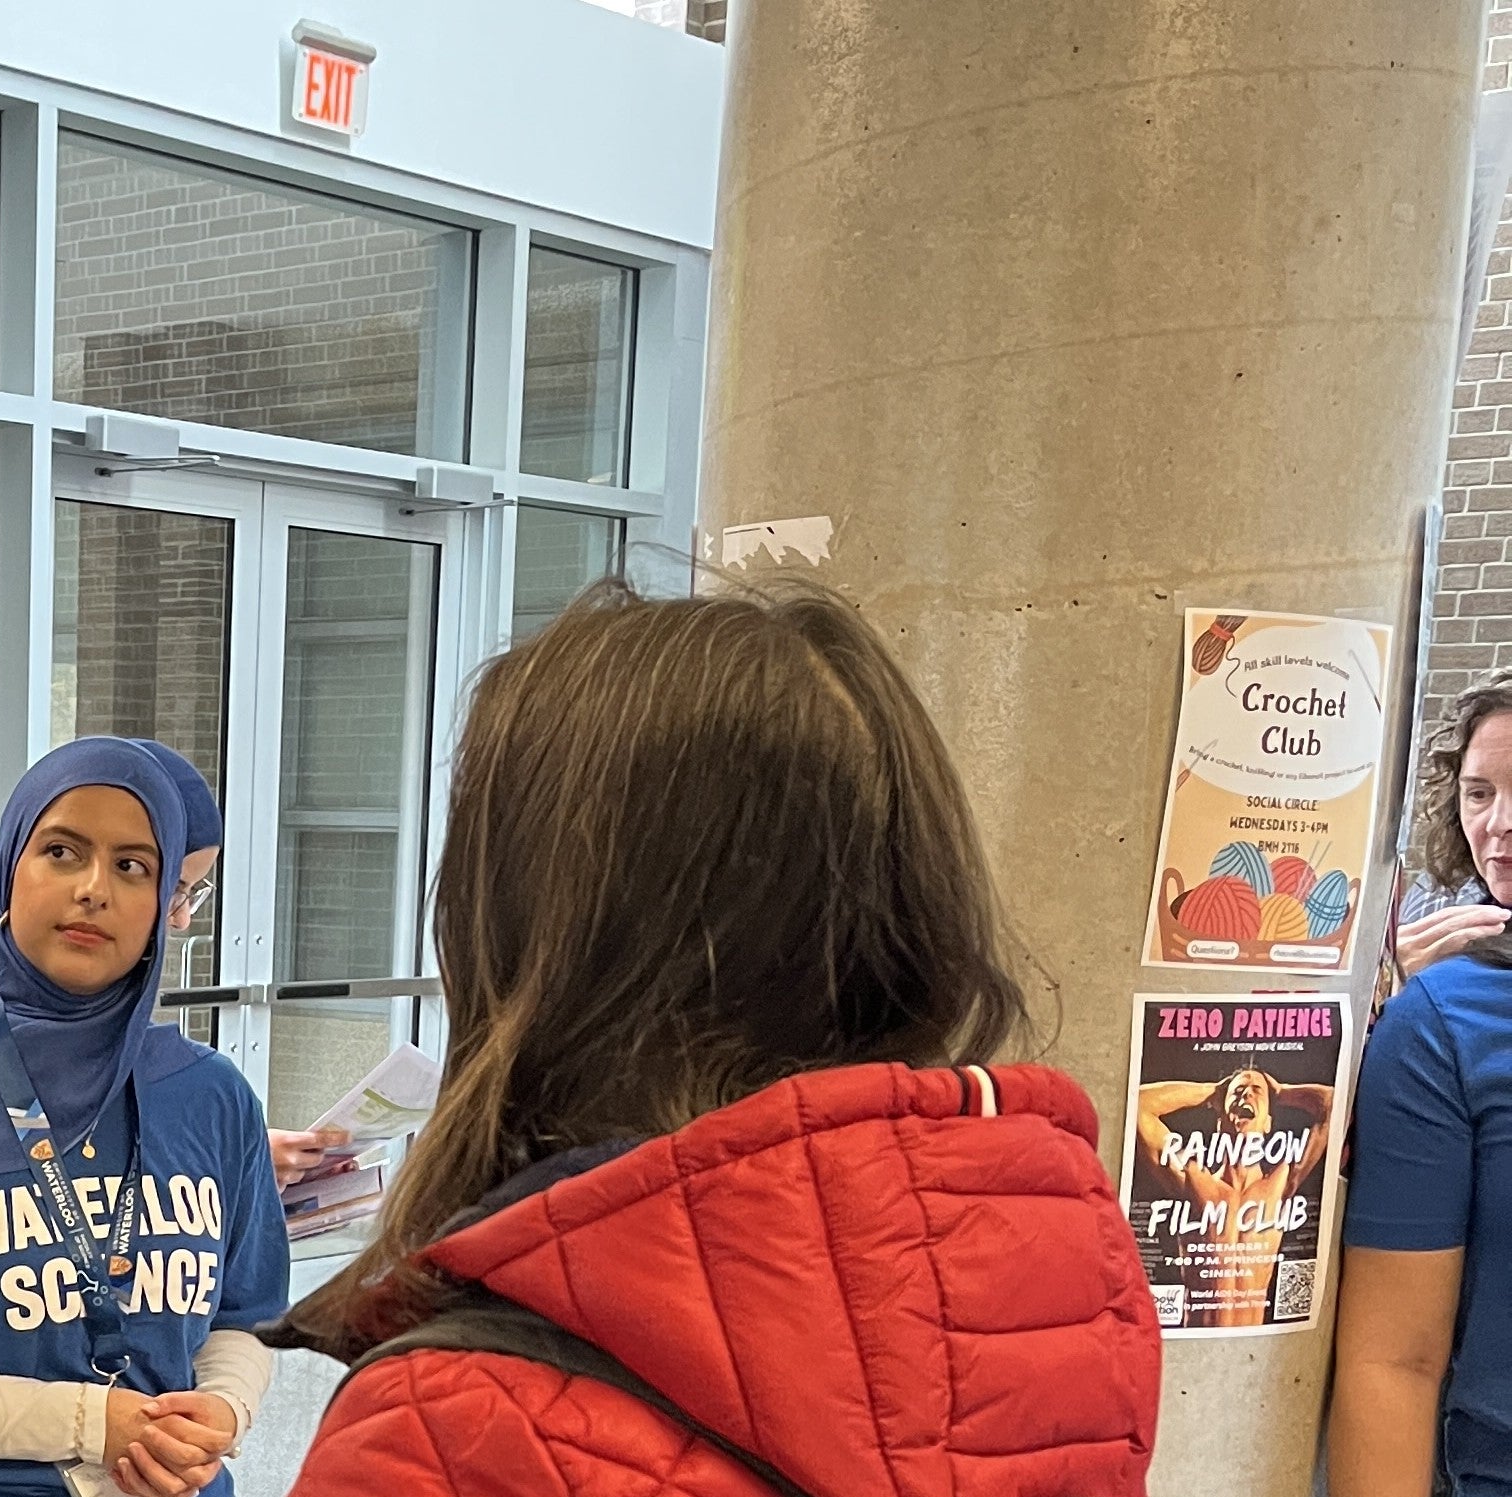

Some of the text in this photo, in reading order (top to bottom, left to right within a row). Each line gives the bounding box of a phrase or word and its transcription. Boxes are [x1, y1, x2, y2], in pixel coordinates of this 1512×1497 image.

[305, 55, 356, 127] EXIT
[1260, 655, 1282, 668] skill
[1242, 683, 1347, 718] Crochet
[1261, 725, 1322, 756] Club
[1246, 795, 1283, 810] SOCIAL
[1230, 816, 1329, 834] WEDNESDAYS 3-4PM
[1258, 840, 1280, 853] BMH
[1157, 1008, 1332, 1039] ZERO PATIENCE
[1160, 1128, 1311, 1168] RAINBOW
[41, 1161, 76, 1228] WATERLOO
[118, 1187, 135, 1255] WATERLOO
[1147, 1199, 1228, 1237] FILM
[1236, 1195, 1308, 1233] CLUB
[1187, 1243, 1261, 1253] DECEMBER
[0, 1248, 218, 1331] SCNCE
[1199, 1269, 1254, 1279] CINEMA
